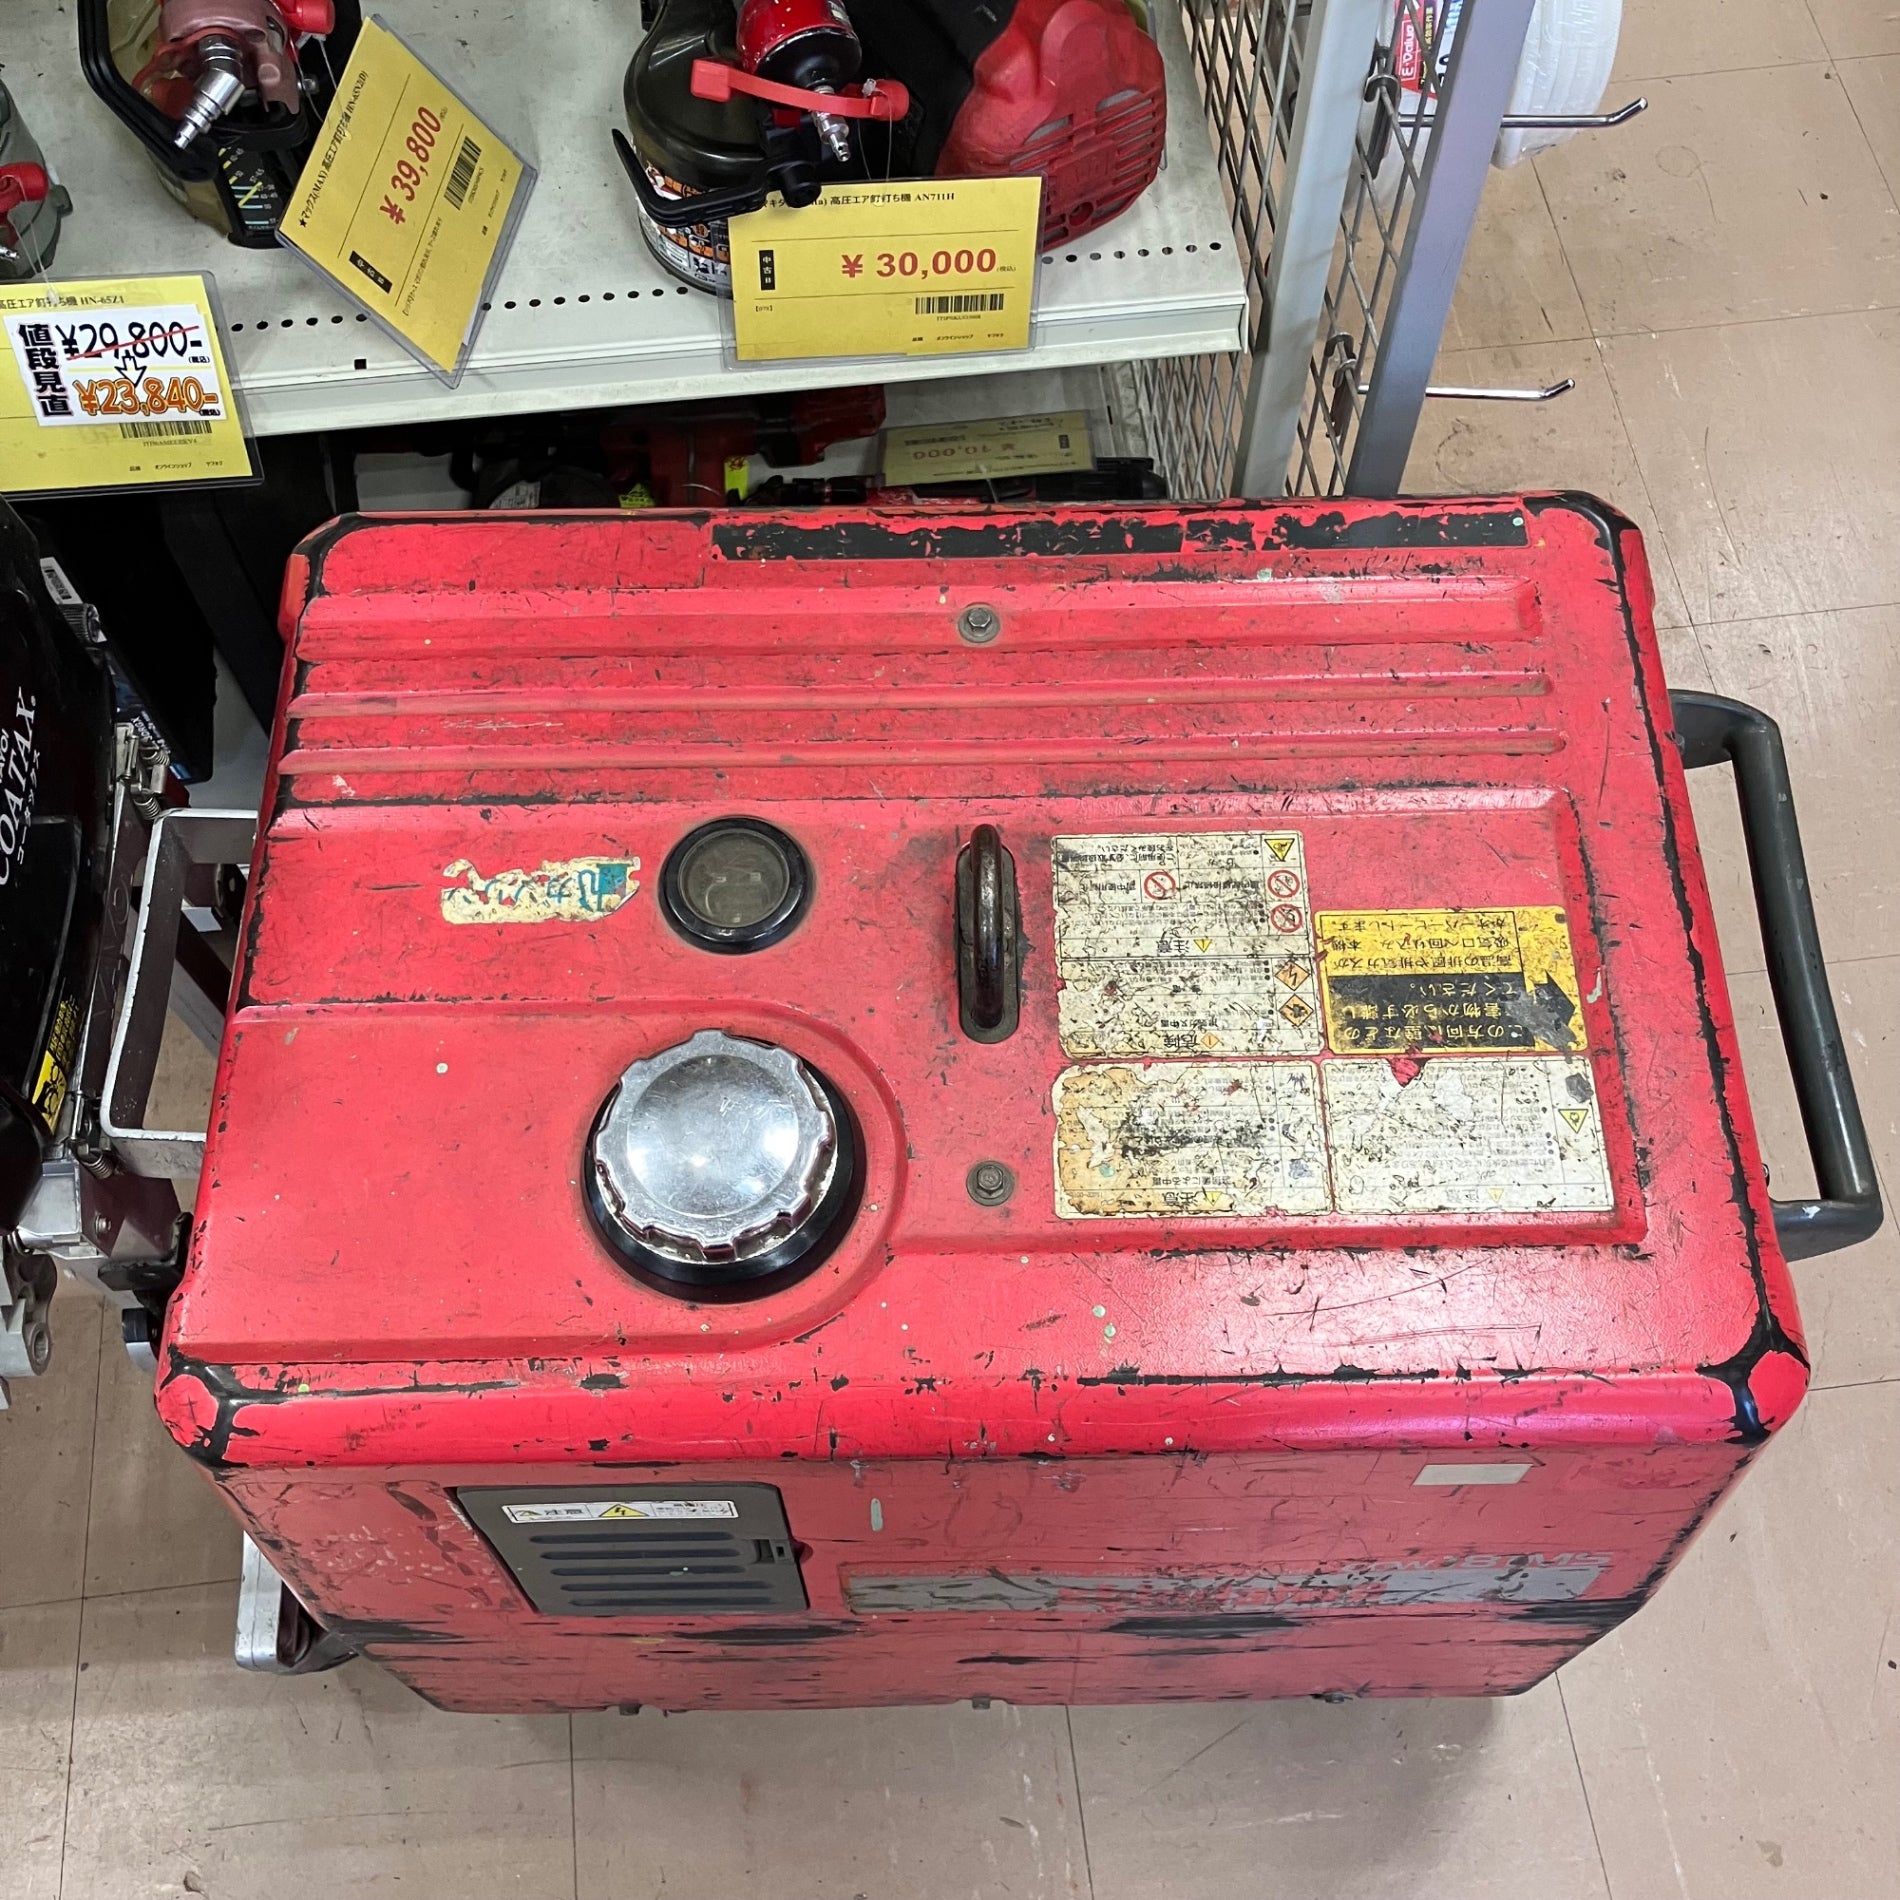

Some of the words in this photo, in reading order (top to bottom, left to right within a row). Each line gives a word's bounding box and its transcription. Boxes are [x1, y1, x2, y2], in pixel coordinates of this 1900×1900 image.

[390, 106, 442, 202] 39,800
[830, 193, 912, 206] 高圧エア釘打ち機
[914, 192, 955, 202] AN711H
[841, 254, 864, 279] ¥
[876, 248, 997, 280] 30,000
[17, 323, 74, 417] 値段見直
[1156, 939, 1190, 954] 注意
[1343, 1004, 1507, 1020] 害物から必ず離し
[1163, 1033, 1199, 1048] 危険
[1162, 1191, 1195, 1208] 注意
